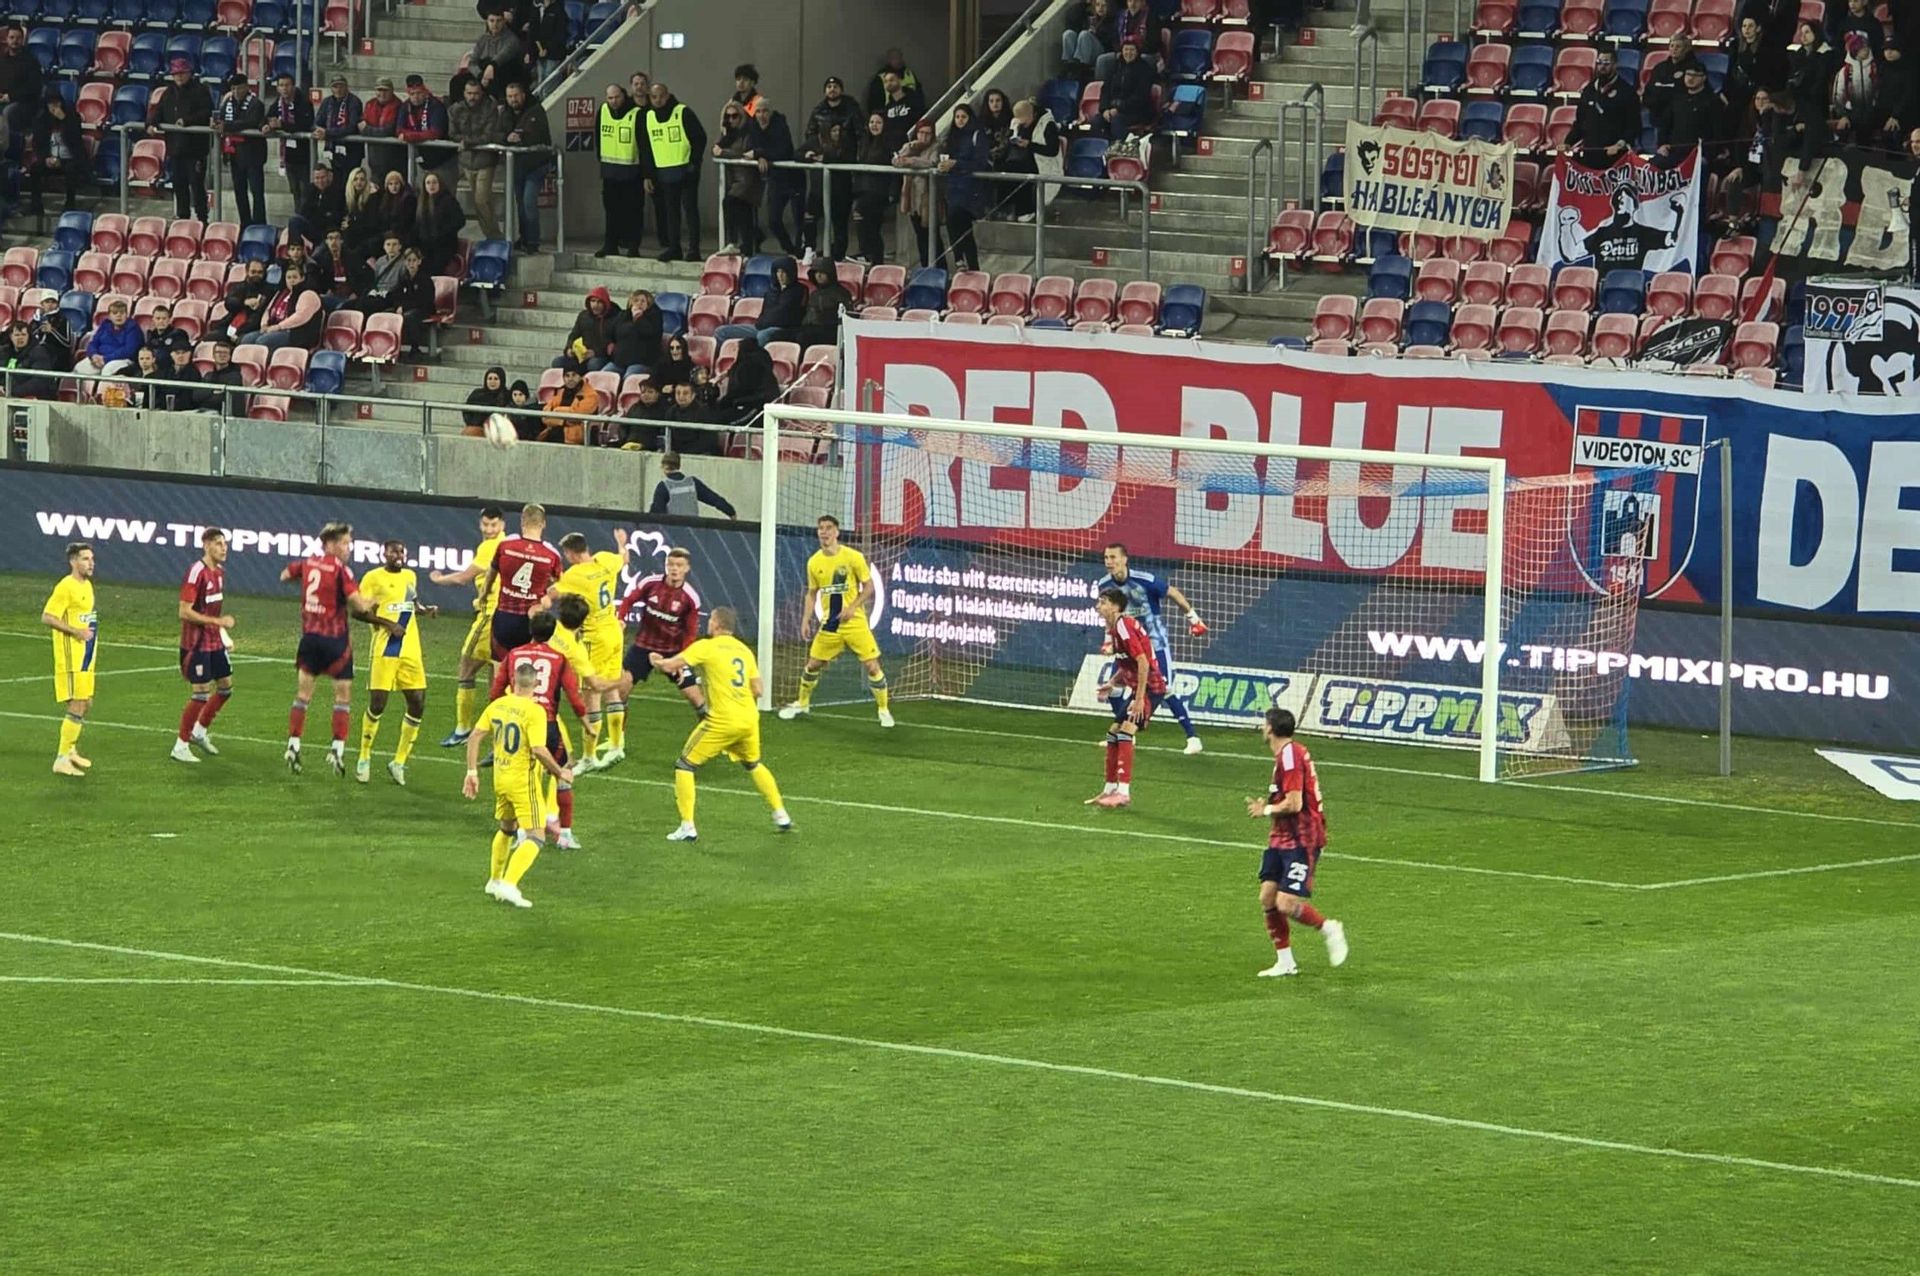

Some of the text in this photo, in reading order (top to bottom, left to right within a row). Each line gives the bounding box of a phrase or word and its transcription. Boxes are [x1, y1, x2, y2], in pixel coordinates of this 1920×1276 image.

[567, 100, 593, 115] 07-24
[1382, 140, 1480, 187] SÓSTÓI
[1351, 180, 1504, 230] HABLEÁNYOK
[1805, 294, 1866, 330] 1997
[880, 363, 1503, 570] RED BLUE
[1583, 441, 1693, 467] VIDEOTON SC
[306, 568, 321, 603] 2
[512, 562, 532, 594] 4
[892, 563, 902, 582] A
[600, 581, 612, 610] 6
[730, 657, 745, 688] 3
[492, 718, 520, 755] 70
[1288, 861, 1309, 882] 25
